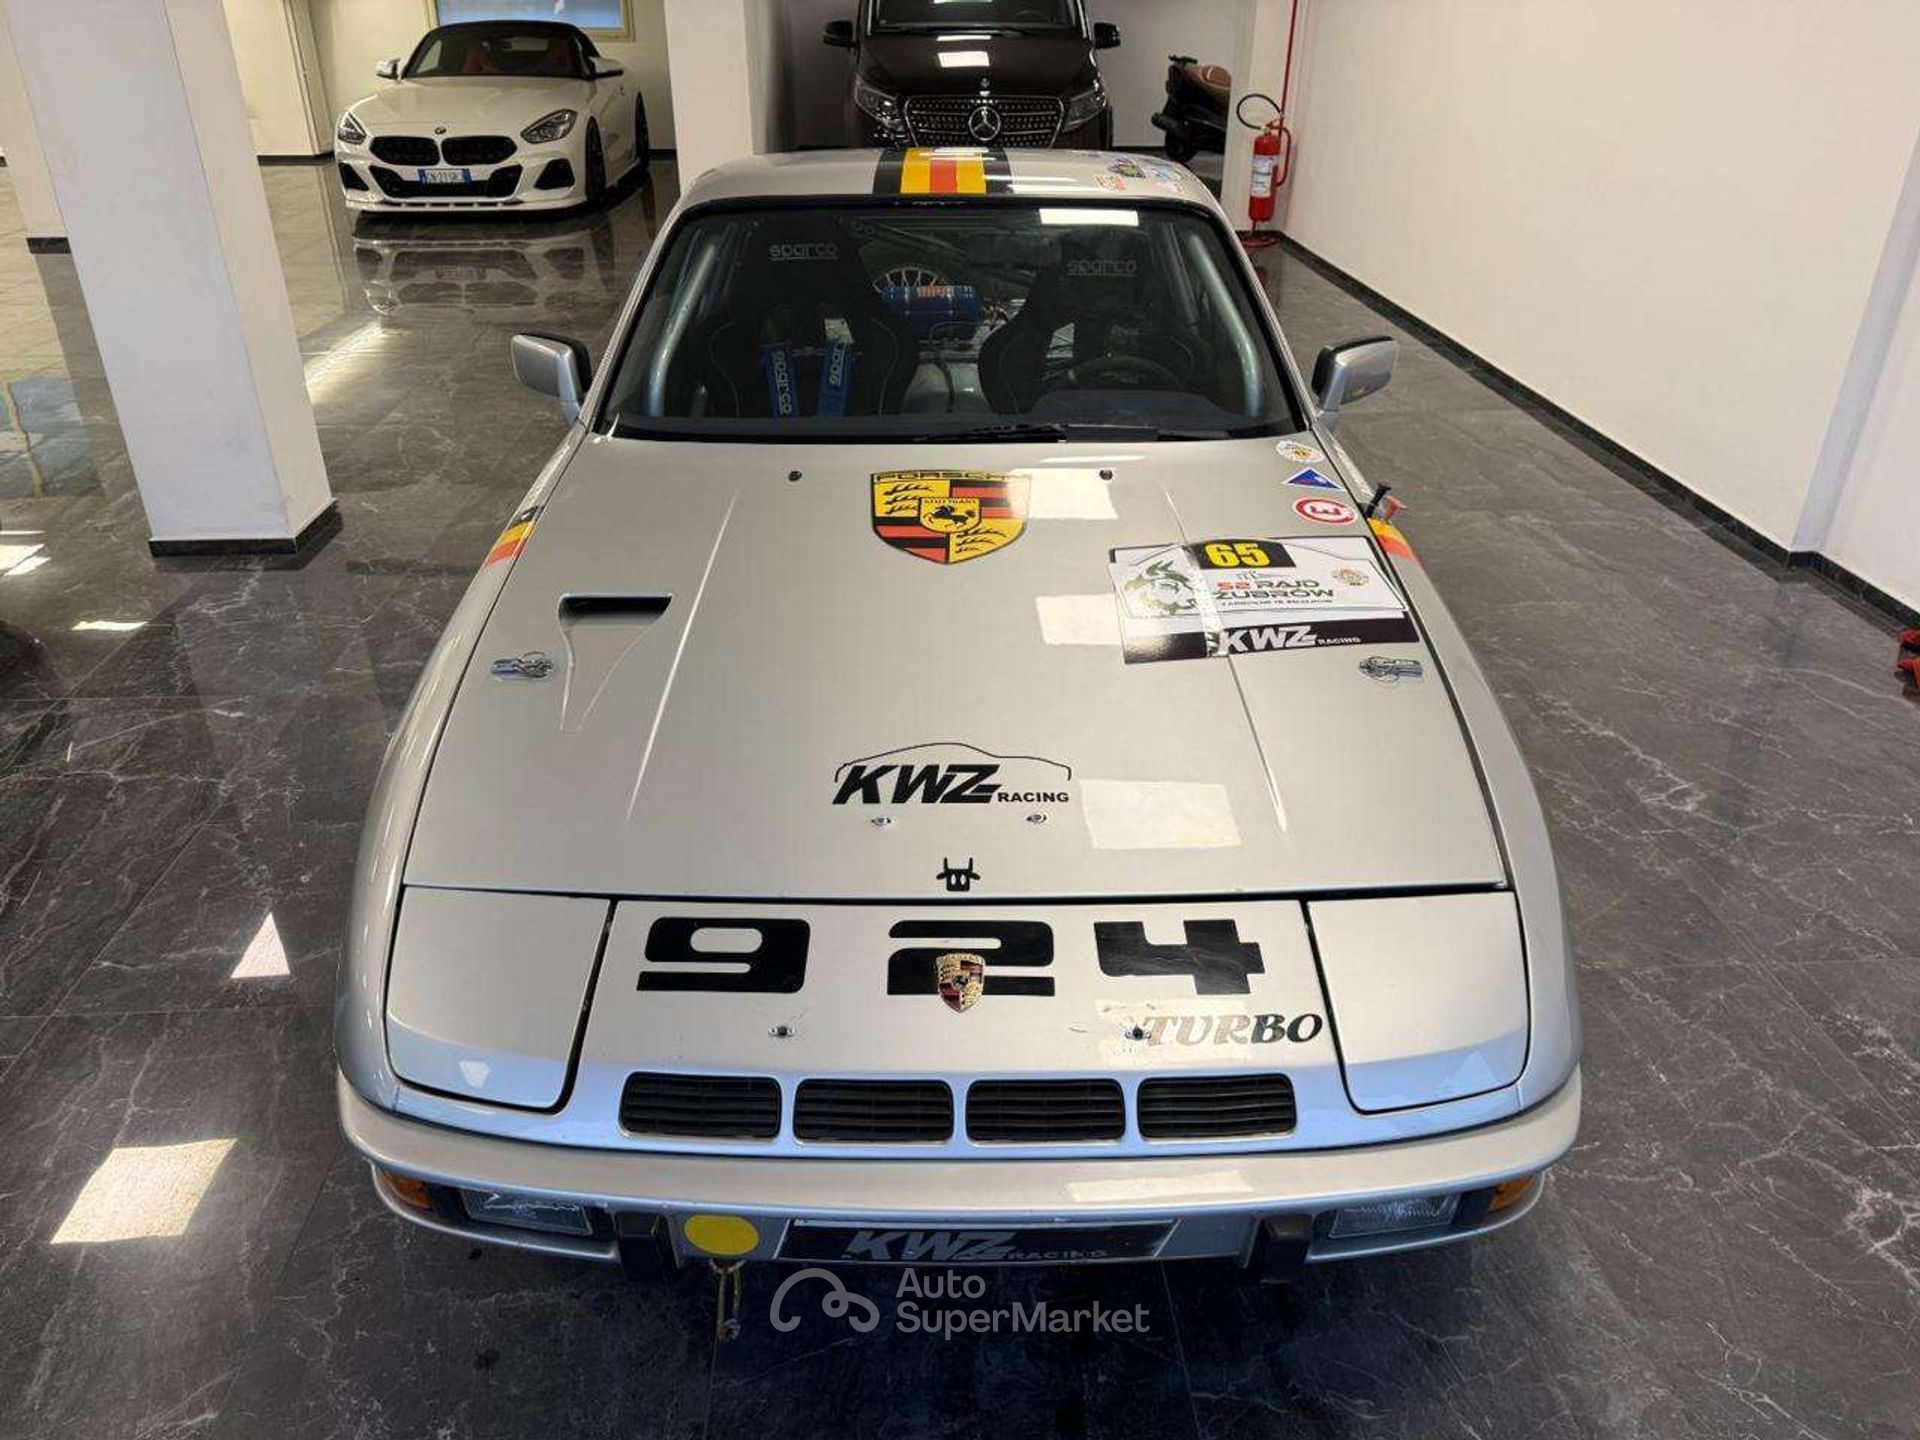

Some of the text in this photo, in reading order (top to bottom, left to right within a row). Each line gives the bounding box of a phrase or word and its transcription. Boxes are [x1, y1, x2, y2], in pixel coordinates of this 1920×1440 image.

[768, 243, 839, 260] sparco
[1067, 260, 1138, 276] sparco
[771, 351, 792, 415] sparco
[1205, 543, 1271, 567] 65
[1256, 579, 1321, 589] RAJD
[1219, 625, 1362, 653] KWZ RACING
[832, 764, 1069, 805] KWZ RACING
[1143, 1013, 1323, 1046] TURBO
[847, 1230, 1107, 1260] KWZ RACING
